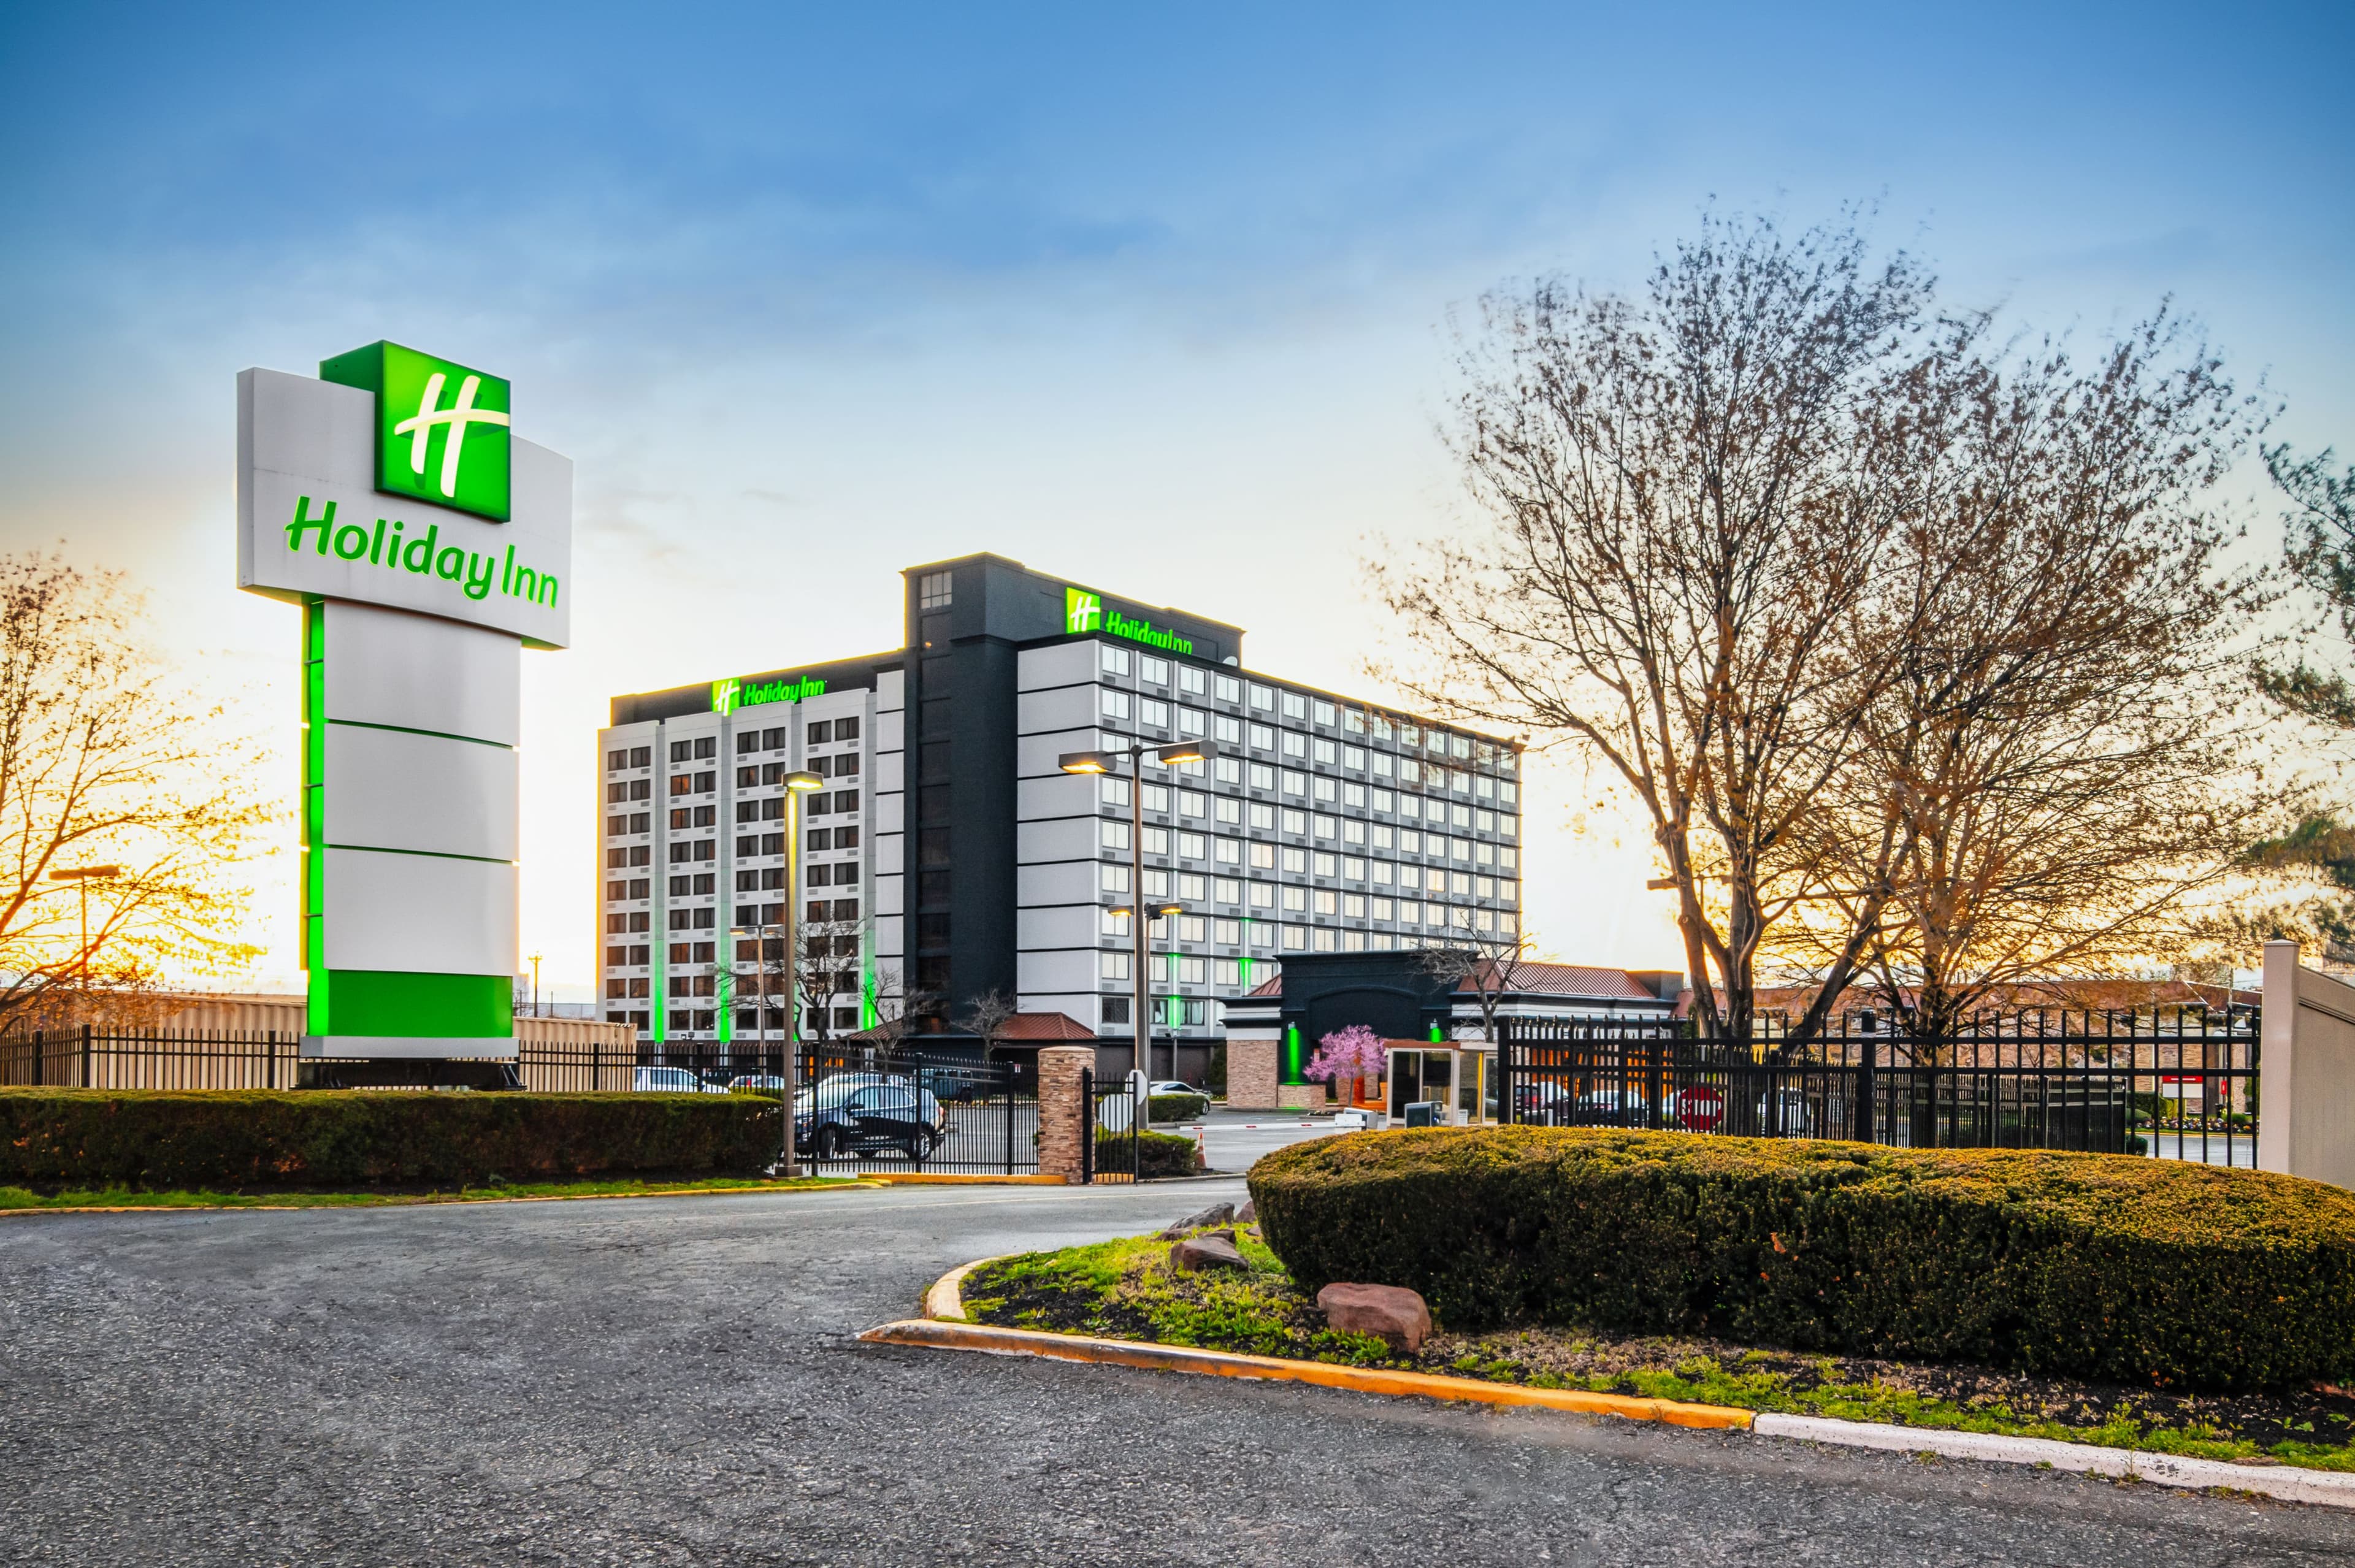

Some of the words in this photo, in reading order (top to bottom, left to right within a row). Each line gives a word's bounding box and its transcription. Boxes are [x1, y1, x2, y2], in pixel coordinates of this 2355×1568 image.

[284, 495, 495, 601] Holiday
[500, 544, 558, 610] Inn
[1106, 611, 1168, 648] Holiday
[1168, 629, 1192, 656] Inn
[743, 680, 800, 706] Holiday
[800, 675, 825, 698] Inn
